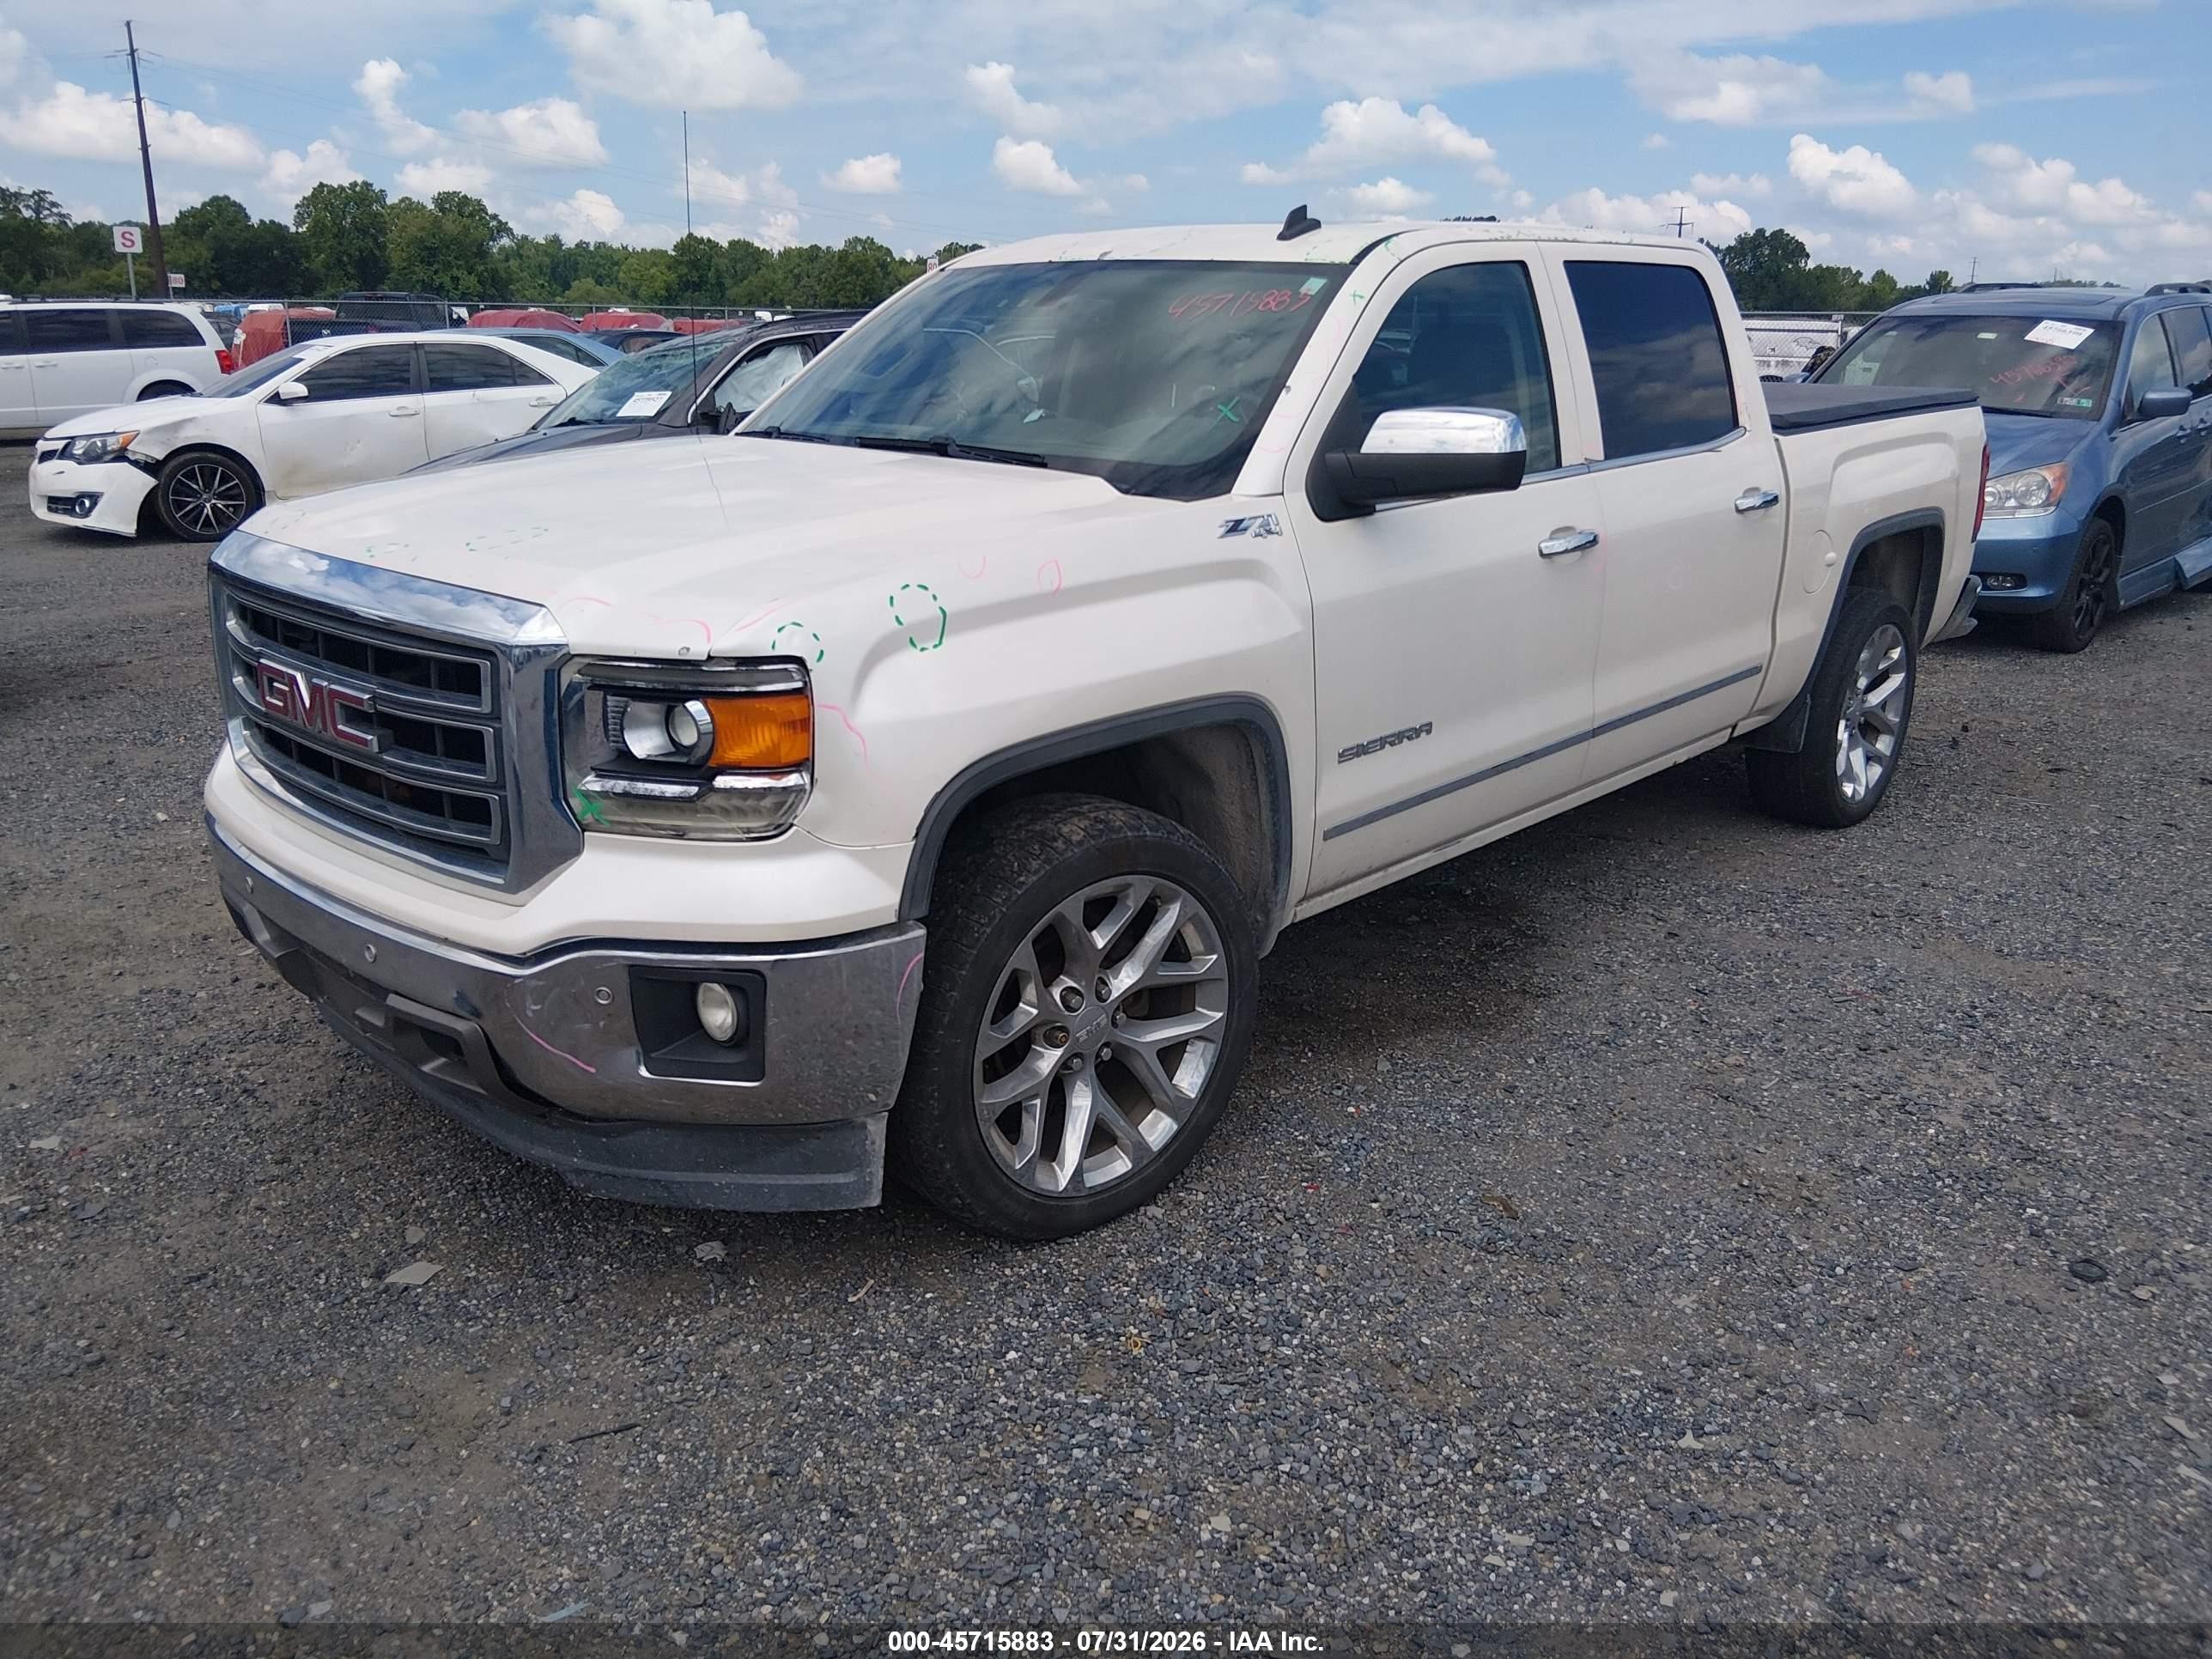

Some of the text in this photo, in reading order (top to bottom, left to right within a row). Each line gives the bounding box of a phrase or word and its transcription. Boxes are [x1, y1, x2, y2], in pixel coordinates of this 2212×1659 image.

[121, 231, 135, 248] S
[258, 658, 379, 752] GMC
[1337, 721, 1432, 764] SIERRA
